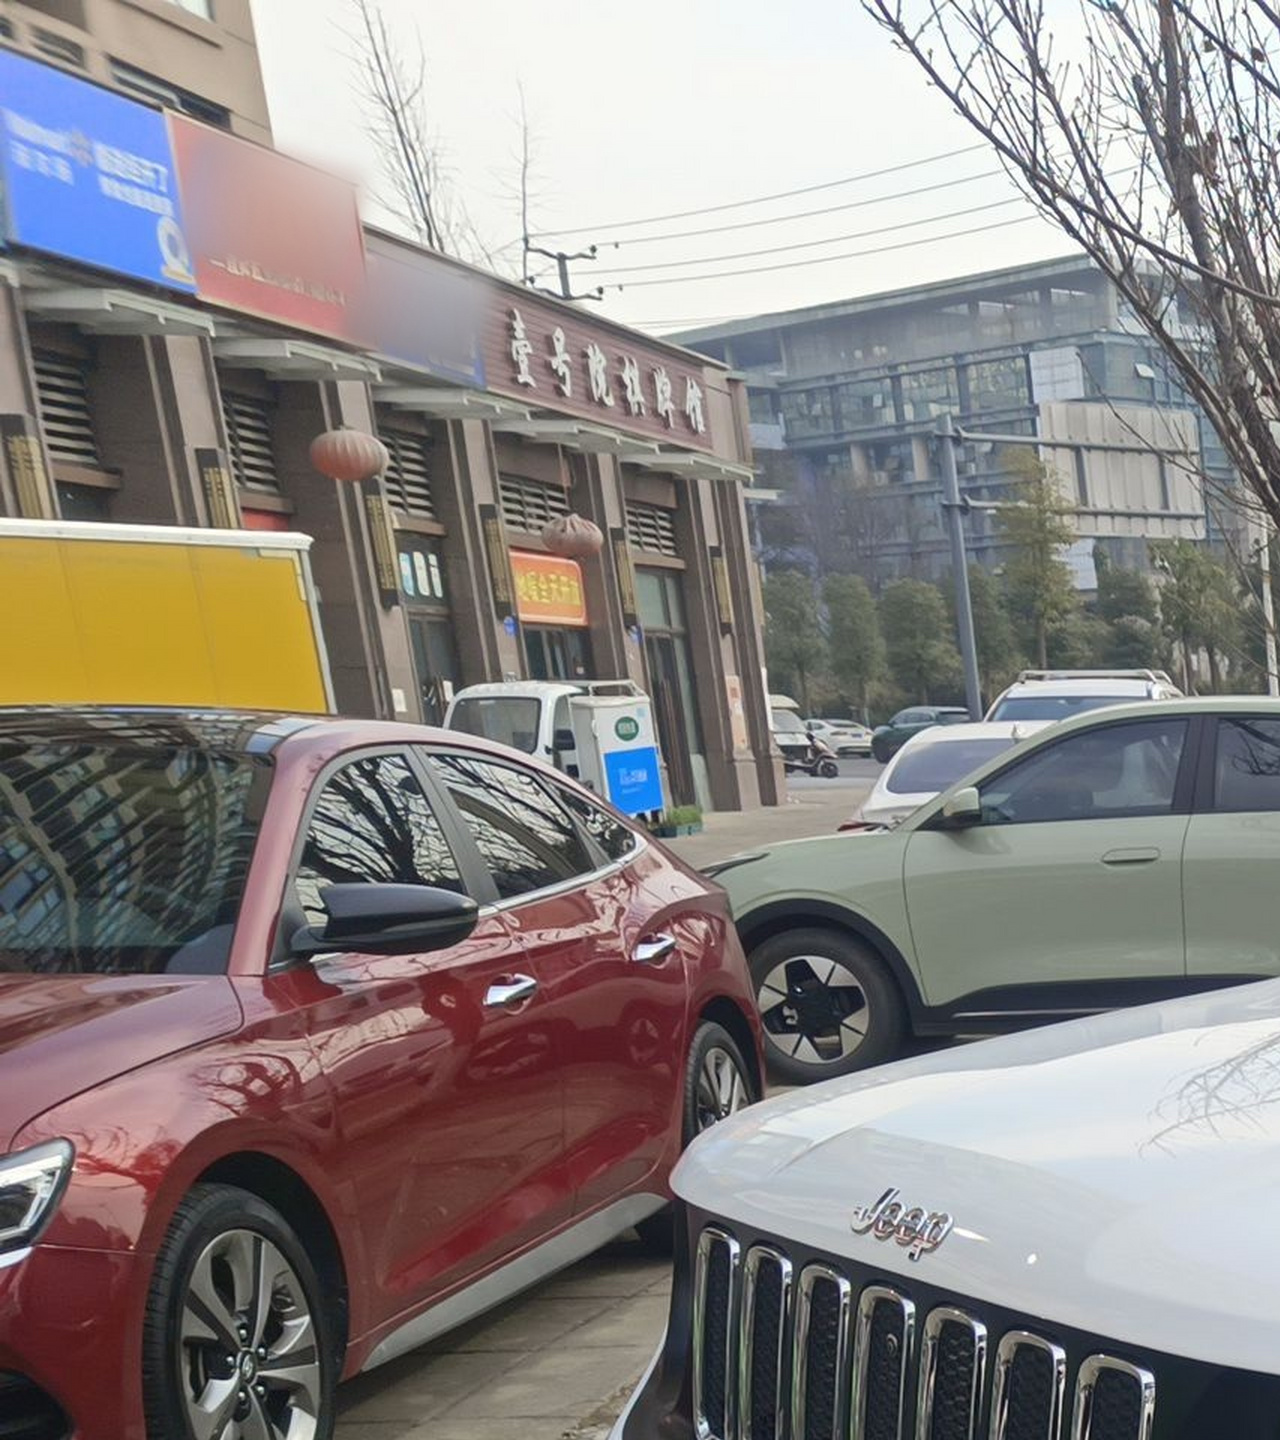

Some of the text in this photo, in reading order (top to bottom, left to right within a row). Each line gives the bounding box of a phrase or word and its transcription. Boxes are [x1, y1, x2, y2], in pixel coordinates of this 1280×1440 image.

[511, 308, 706, 434] 壹号院棋牌馆
[851, 1187, 954, 1262] Jeep
